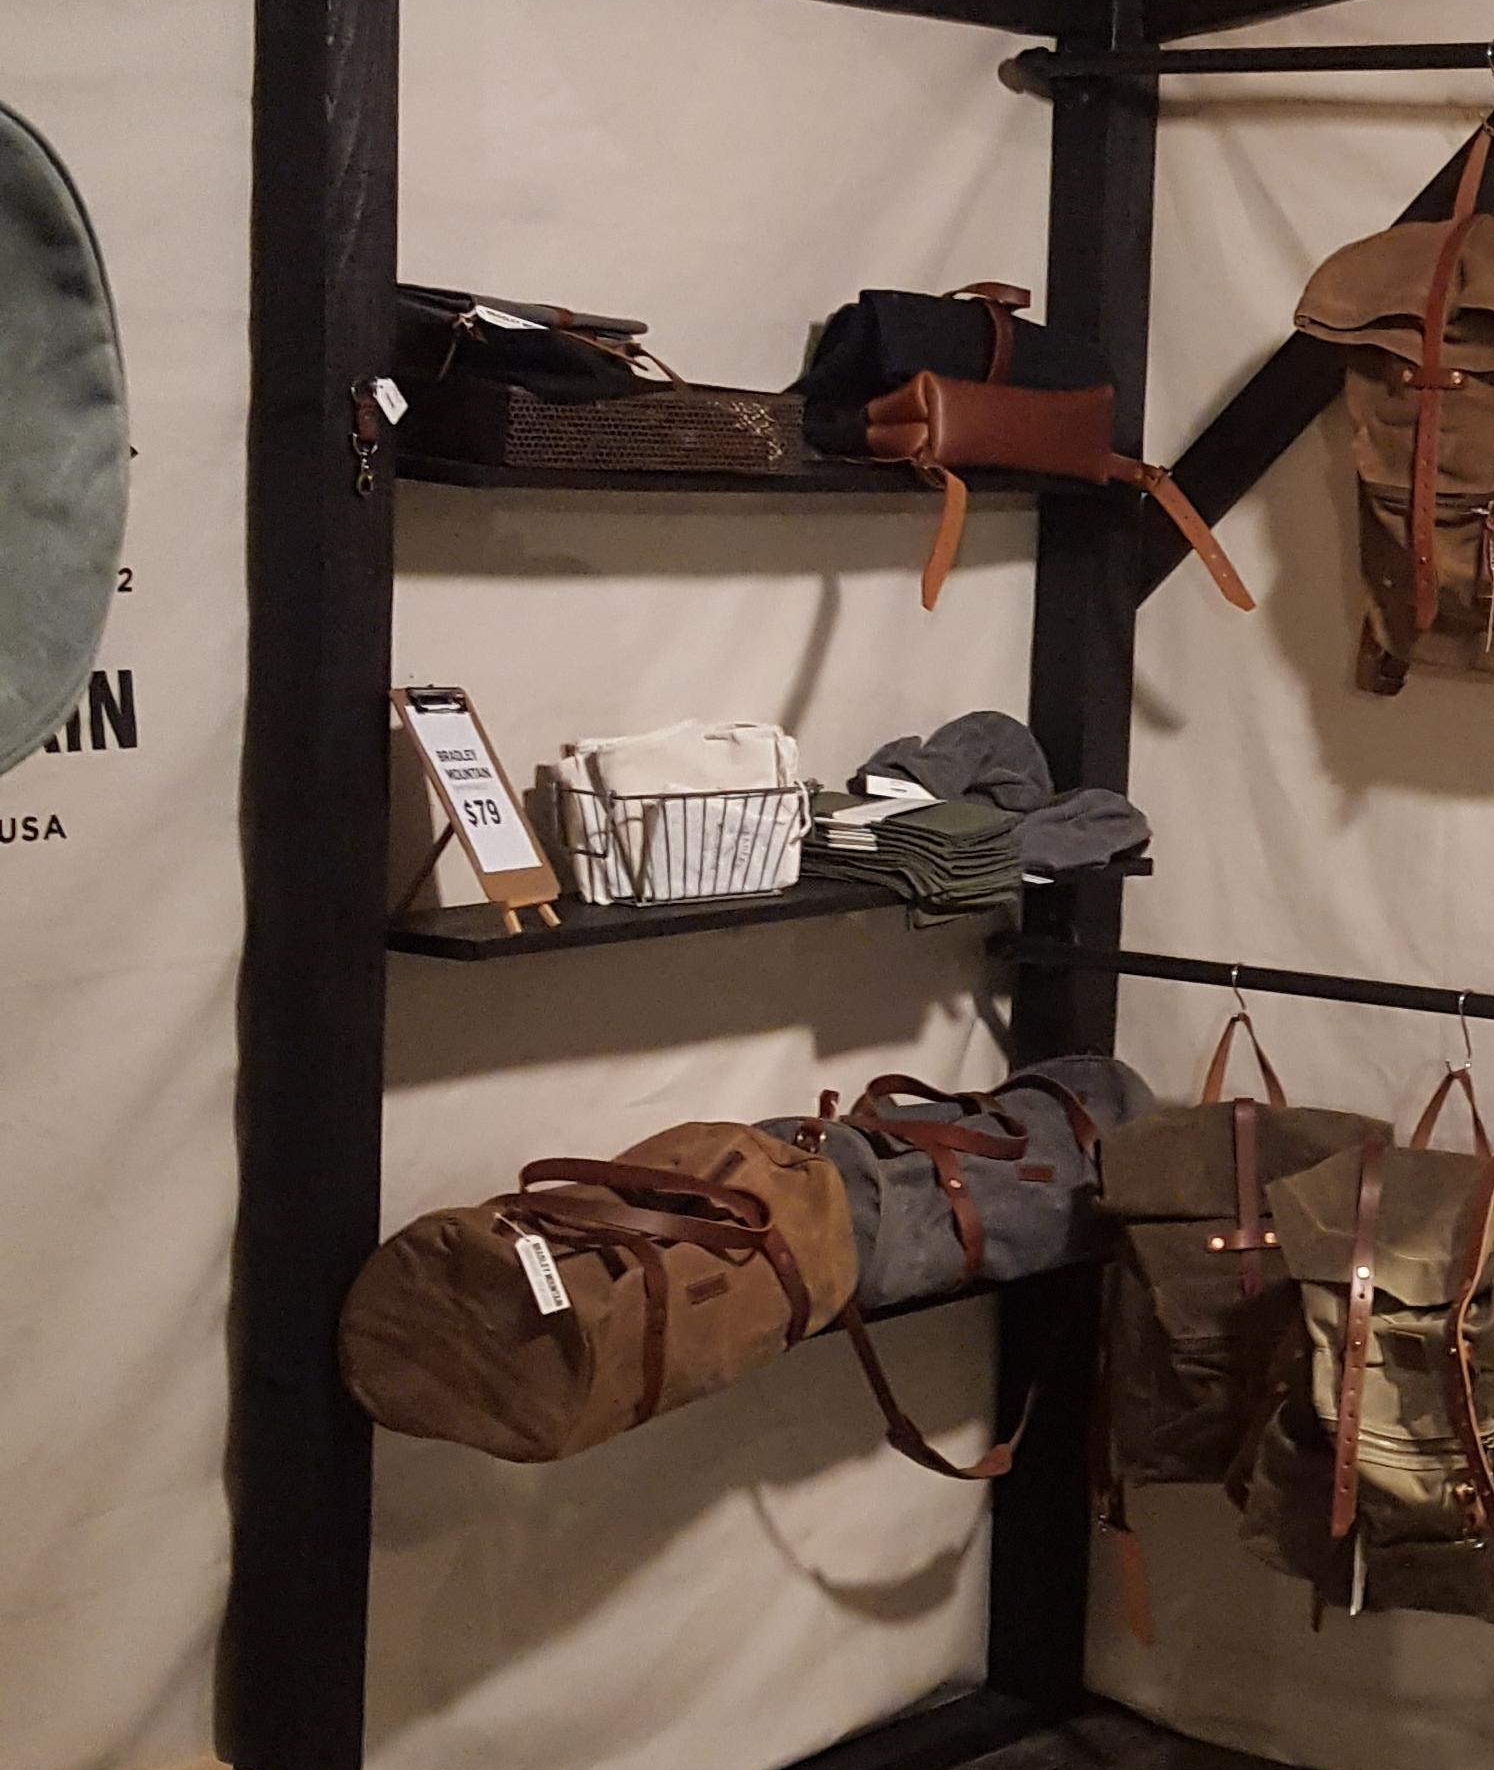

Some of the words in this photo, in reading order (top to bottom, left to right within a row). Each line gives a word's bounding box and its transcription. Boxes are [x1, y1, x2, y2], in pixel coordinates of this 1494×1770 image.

[435, 749, 478, 763] BRADLEY
[444, 767, 492, 781] MOUNTAIN
[463, 799, 502, 828] $79
[0, 814, 67, 844] USA
